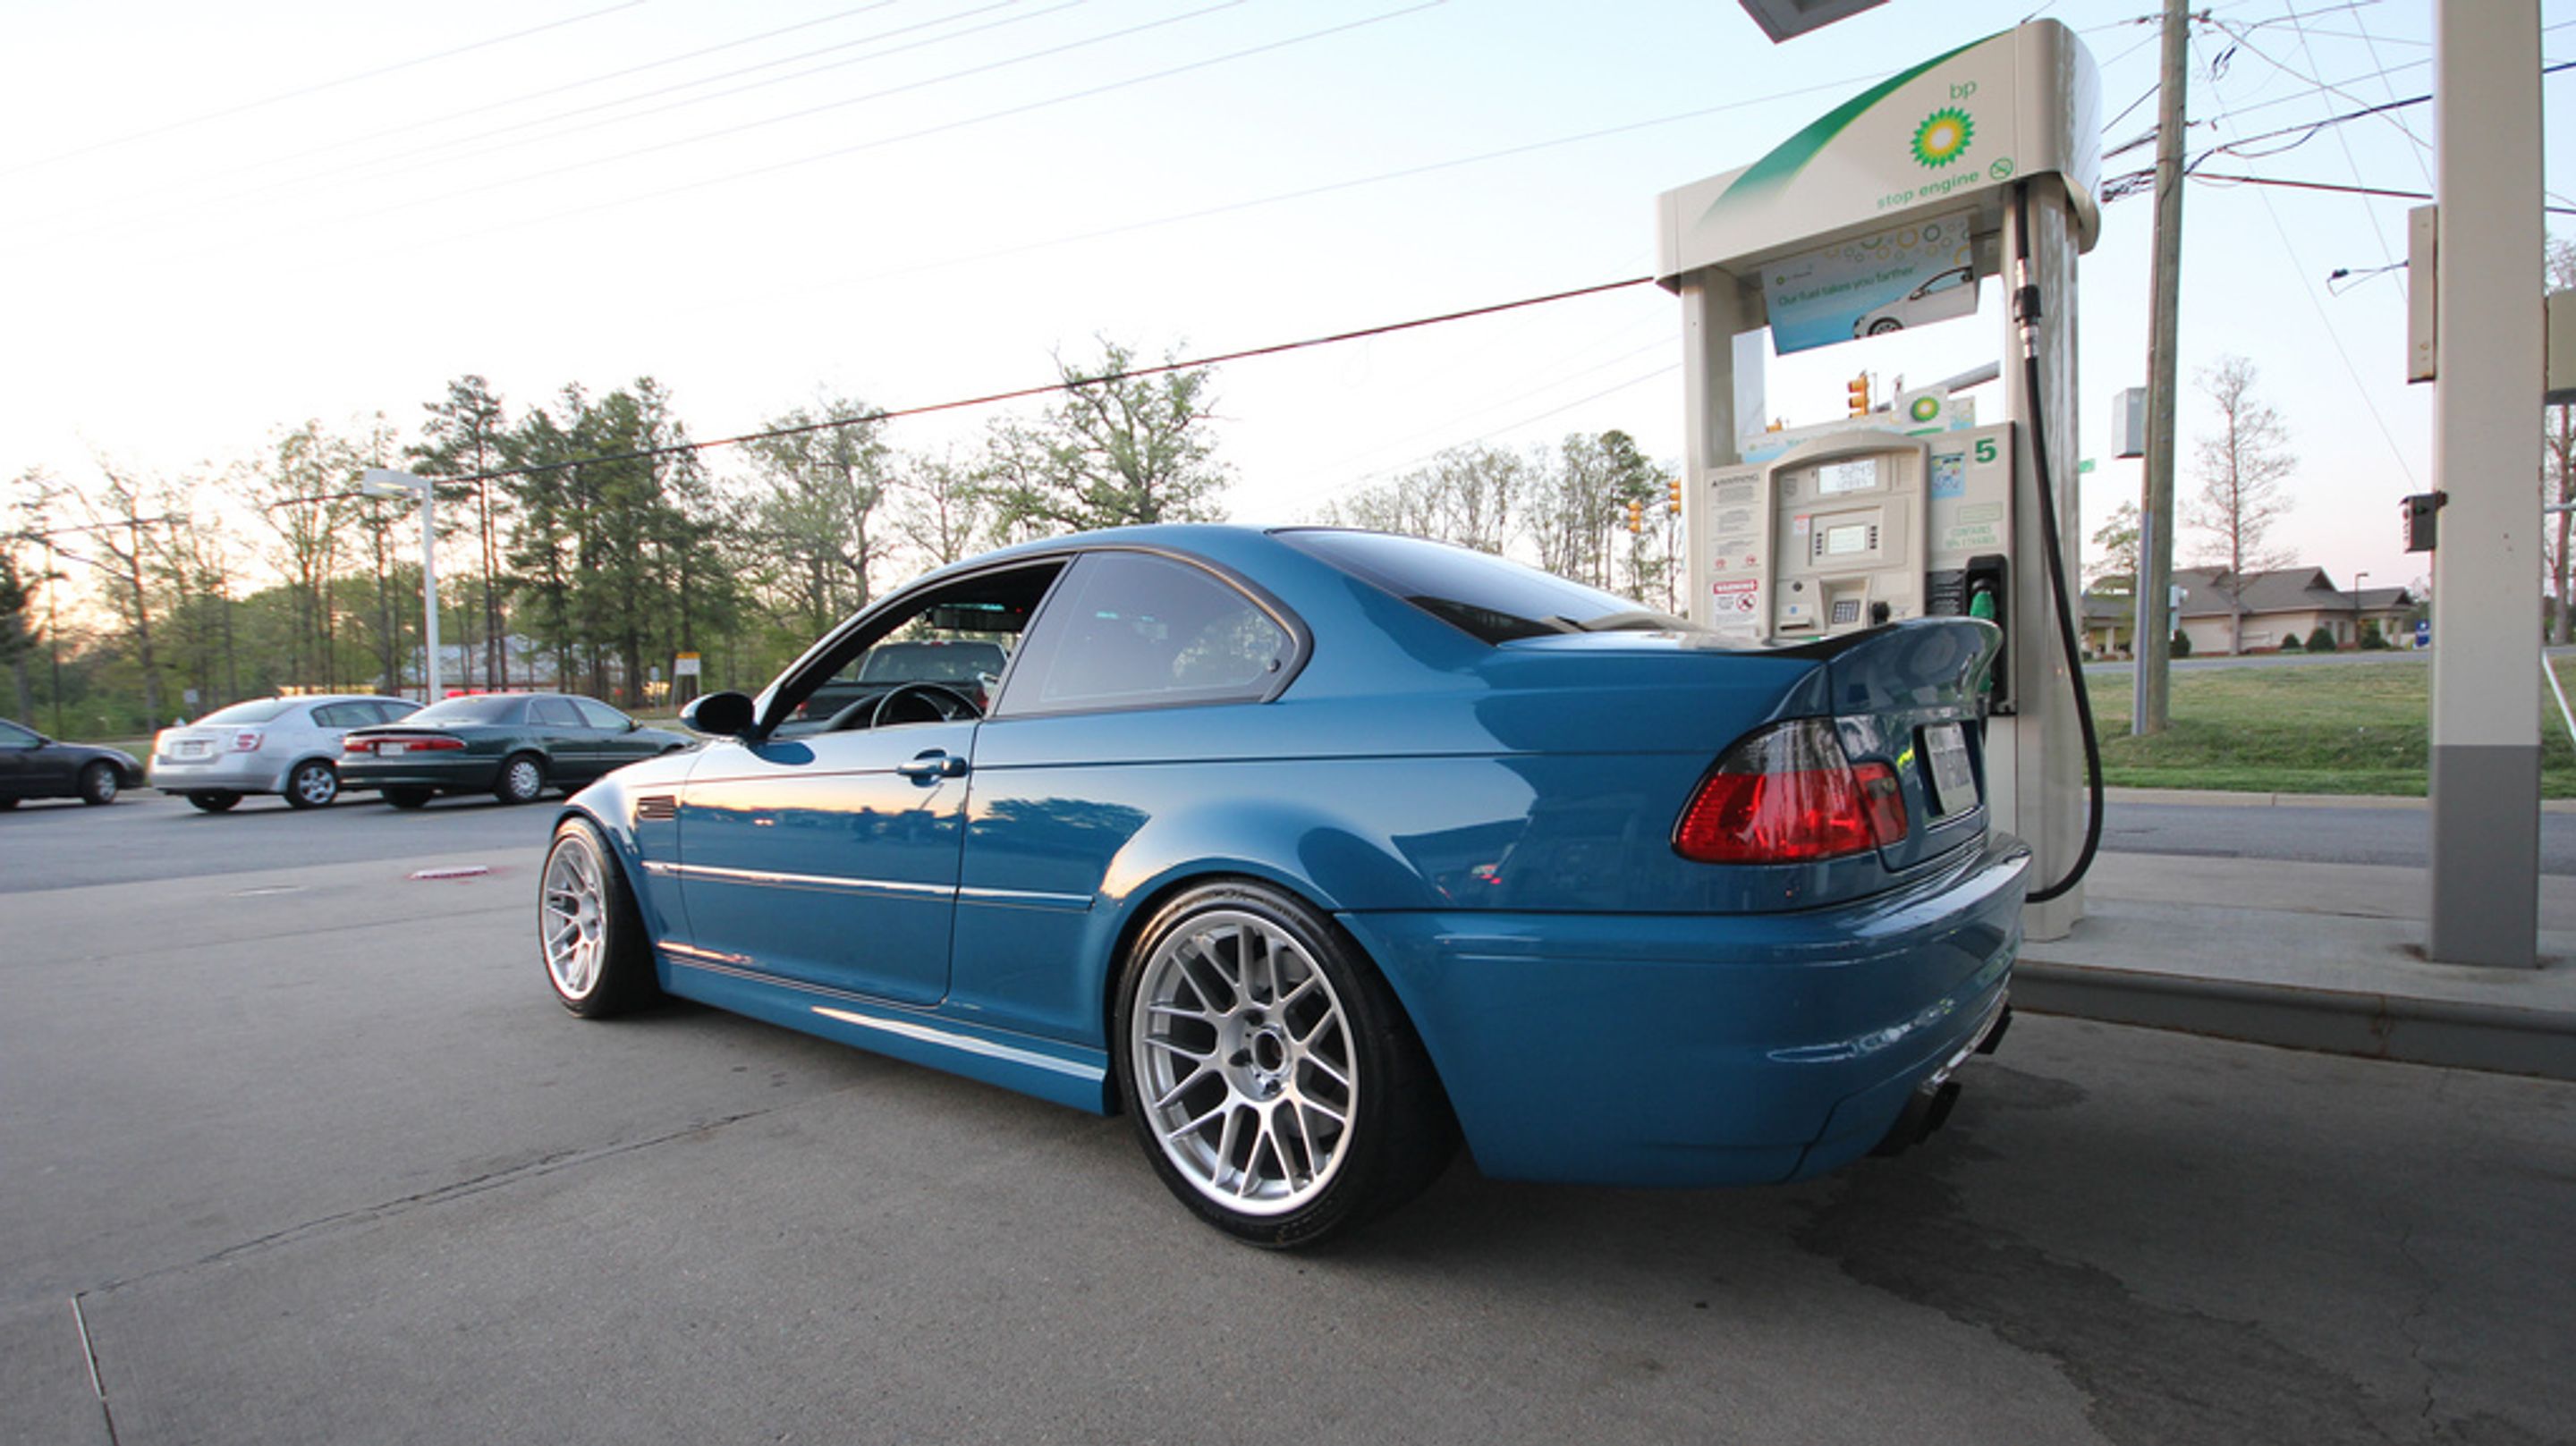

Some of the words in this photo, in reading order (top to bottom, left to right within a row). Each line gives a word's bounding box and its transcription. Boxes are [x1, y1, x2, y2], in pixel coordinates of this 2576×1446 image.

[1950, 80, 1977, 100] bp
[1877, 190, 1914, 209] stop
[1919, 172, 1979, 196] engine
[1777, 296, 1798, 307] Our
[1800, 288, 1820, 302] fuel
[1822, 282, 1852, 296] takes
[1852, 278, 1876, 291] you
[1876, 266, 1914, 282] farther
[1975, 437, 1997, 463] 5
